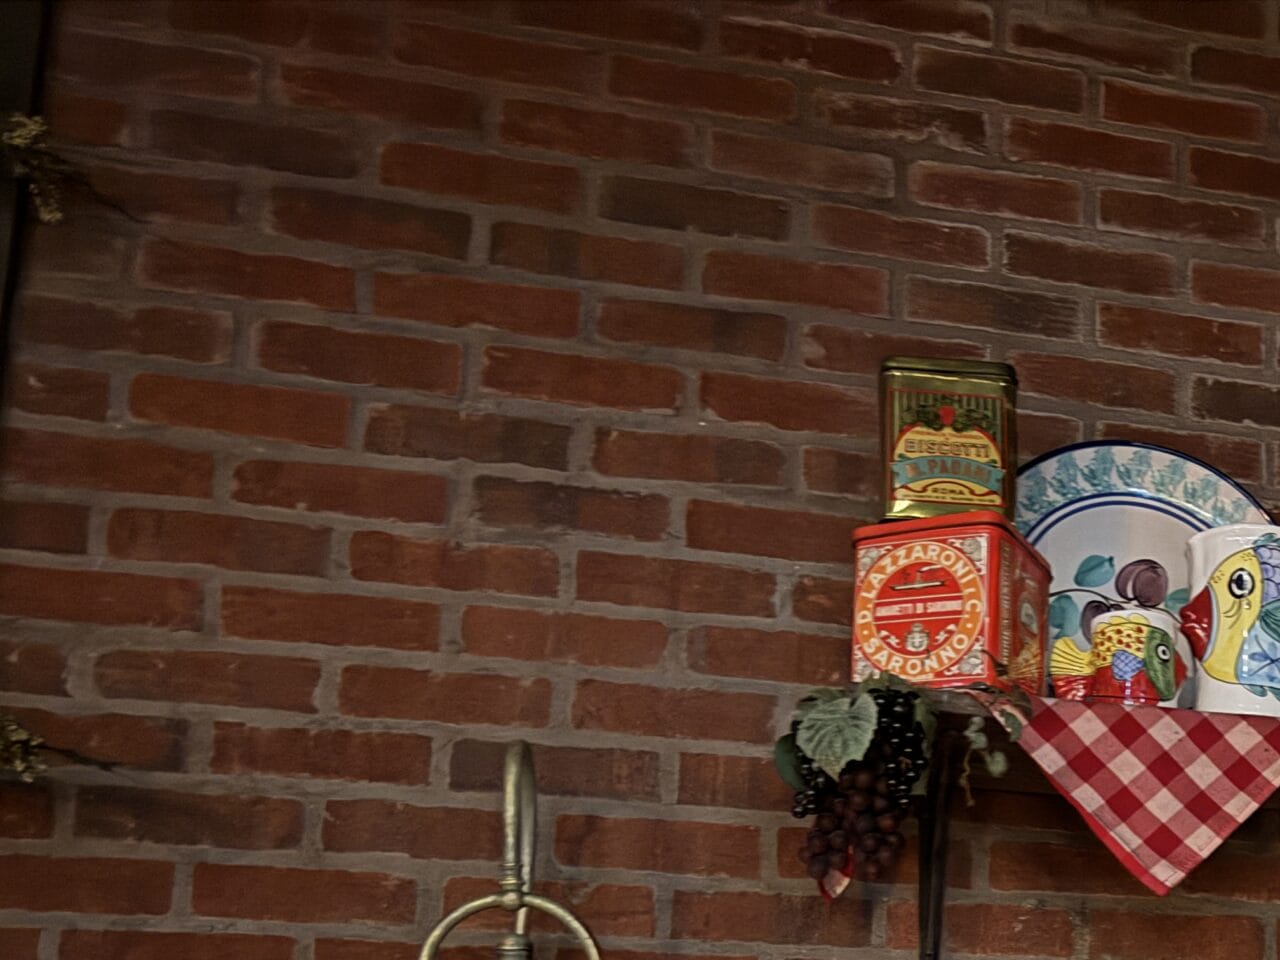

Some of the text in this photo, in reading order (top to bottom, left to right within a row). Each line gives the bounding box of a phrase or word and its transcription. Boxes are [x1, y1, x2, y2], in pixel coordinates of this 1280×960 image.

[904, 439, 989, 458] BISCOTTI
[861, 545, 978, 599] LAZZARONI
[863, 634, 969, 675] SARONNO
